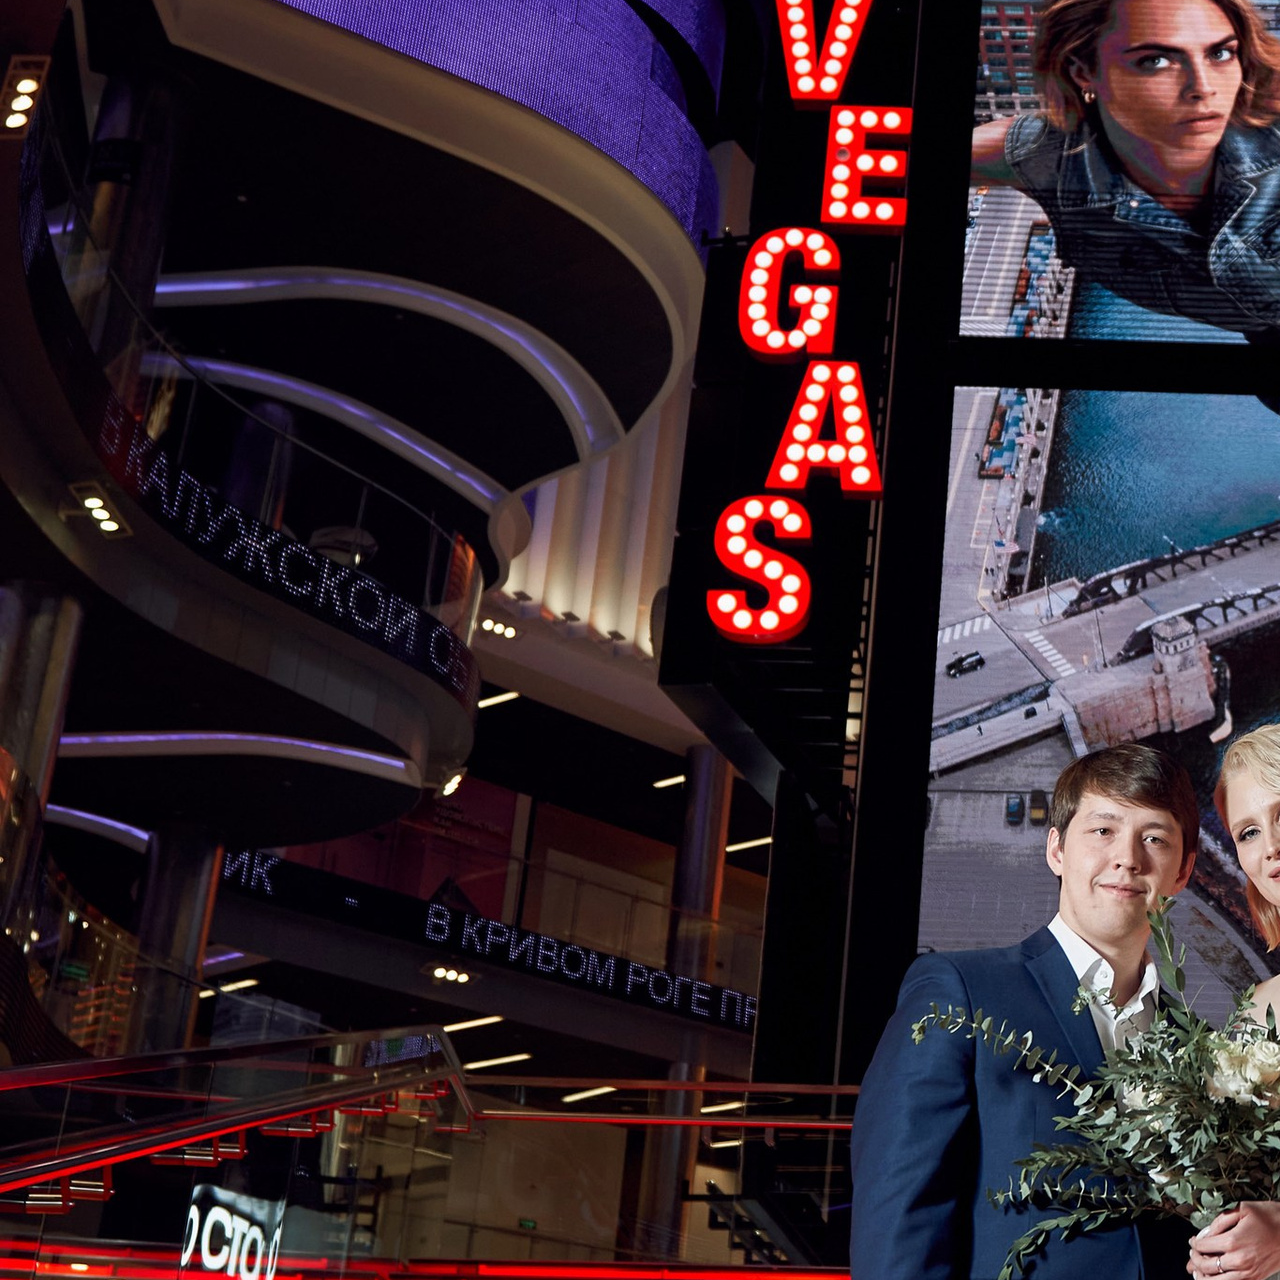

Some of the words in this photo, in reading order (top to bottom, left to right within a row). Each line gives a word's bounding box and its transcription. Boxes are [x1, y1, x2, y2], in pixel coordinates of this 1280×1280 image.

[124, 424, 422, 657] КАЛУЖСКОЙ
[425, 902, 451, 944] В
[461, 913, 617, 990] КРИВОМ
[625, 960, 713, 1018] РОГЕ
